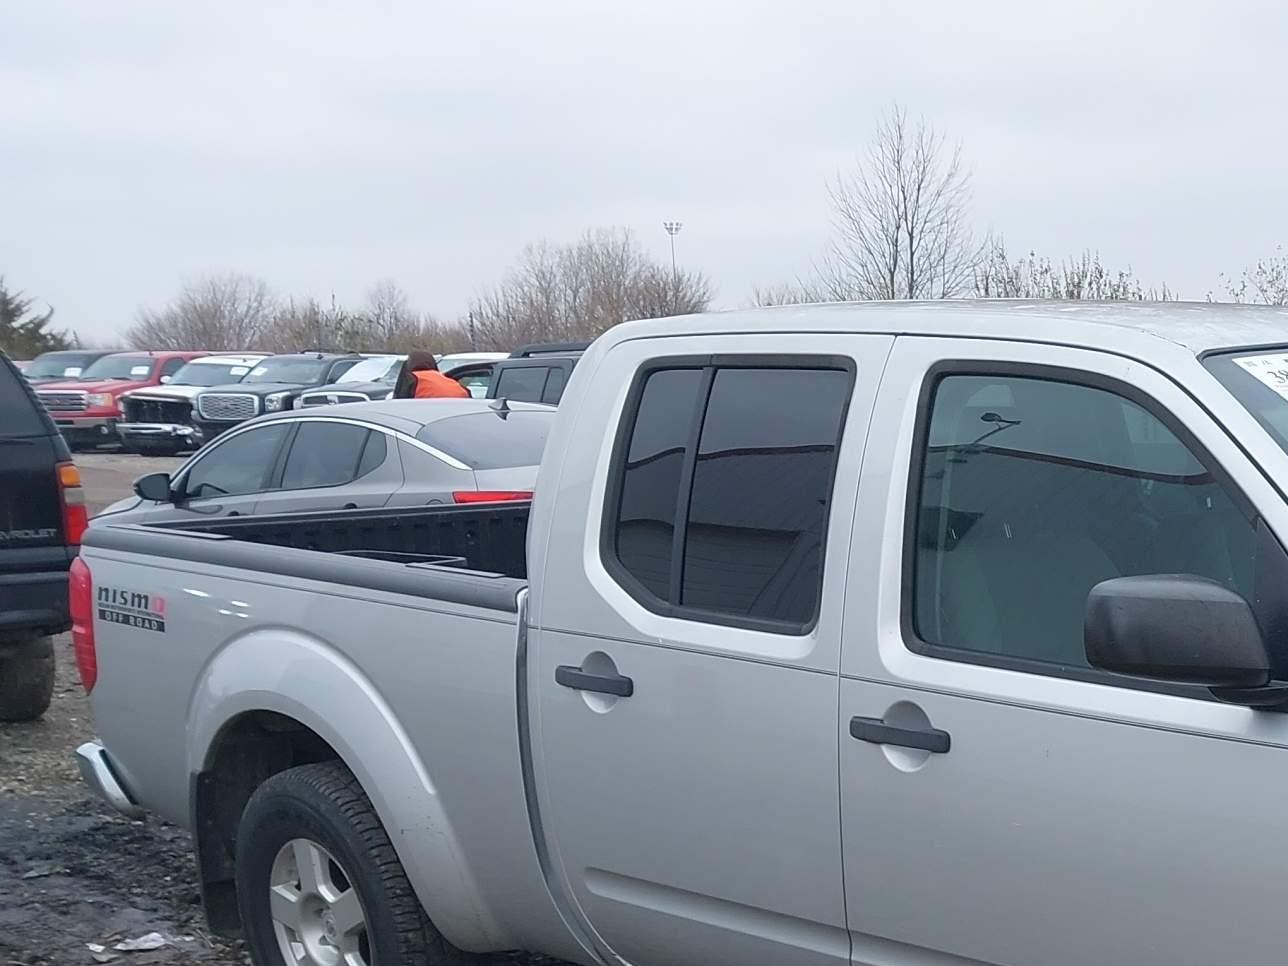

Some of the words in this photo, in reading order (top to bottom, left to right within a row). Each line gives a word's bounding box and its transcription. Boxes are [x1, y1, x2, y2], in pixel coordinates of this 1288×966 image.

[0, 528, 57, 541] VROLET
[104, 611, 125, 622] OFF
[128, 615, 158, 630] ROAD
